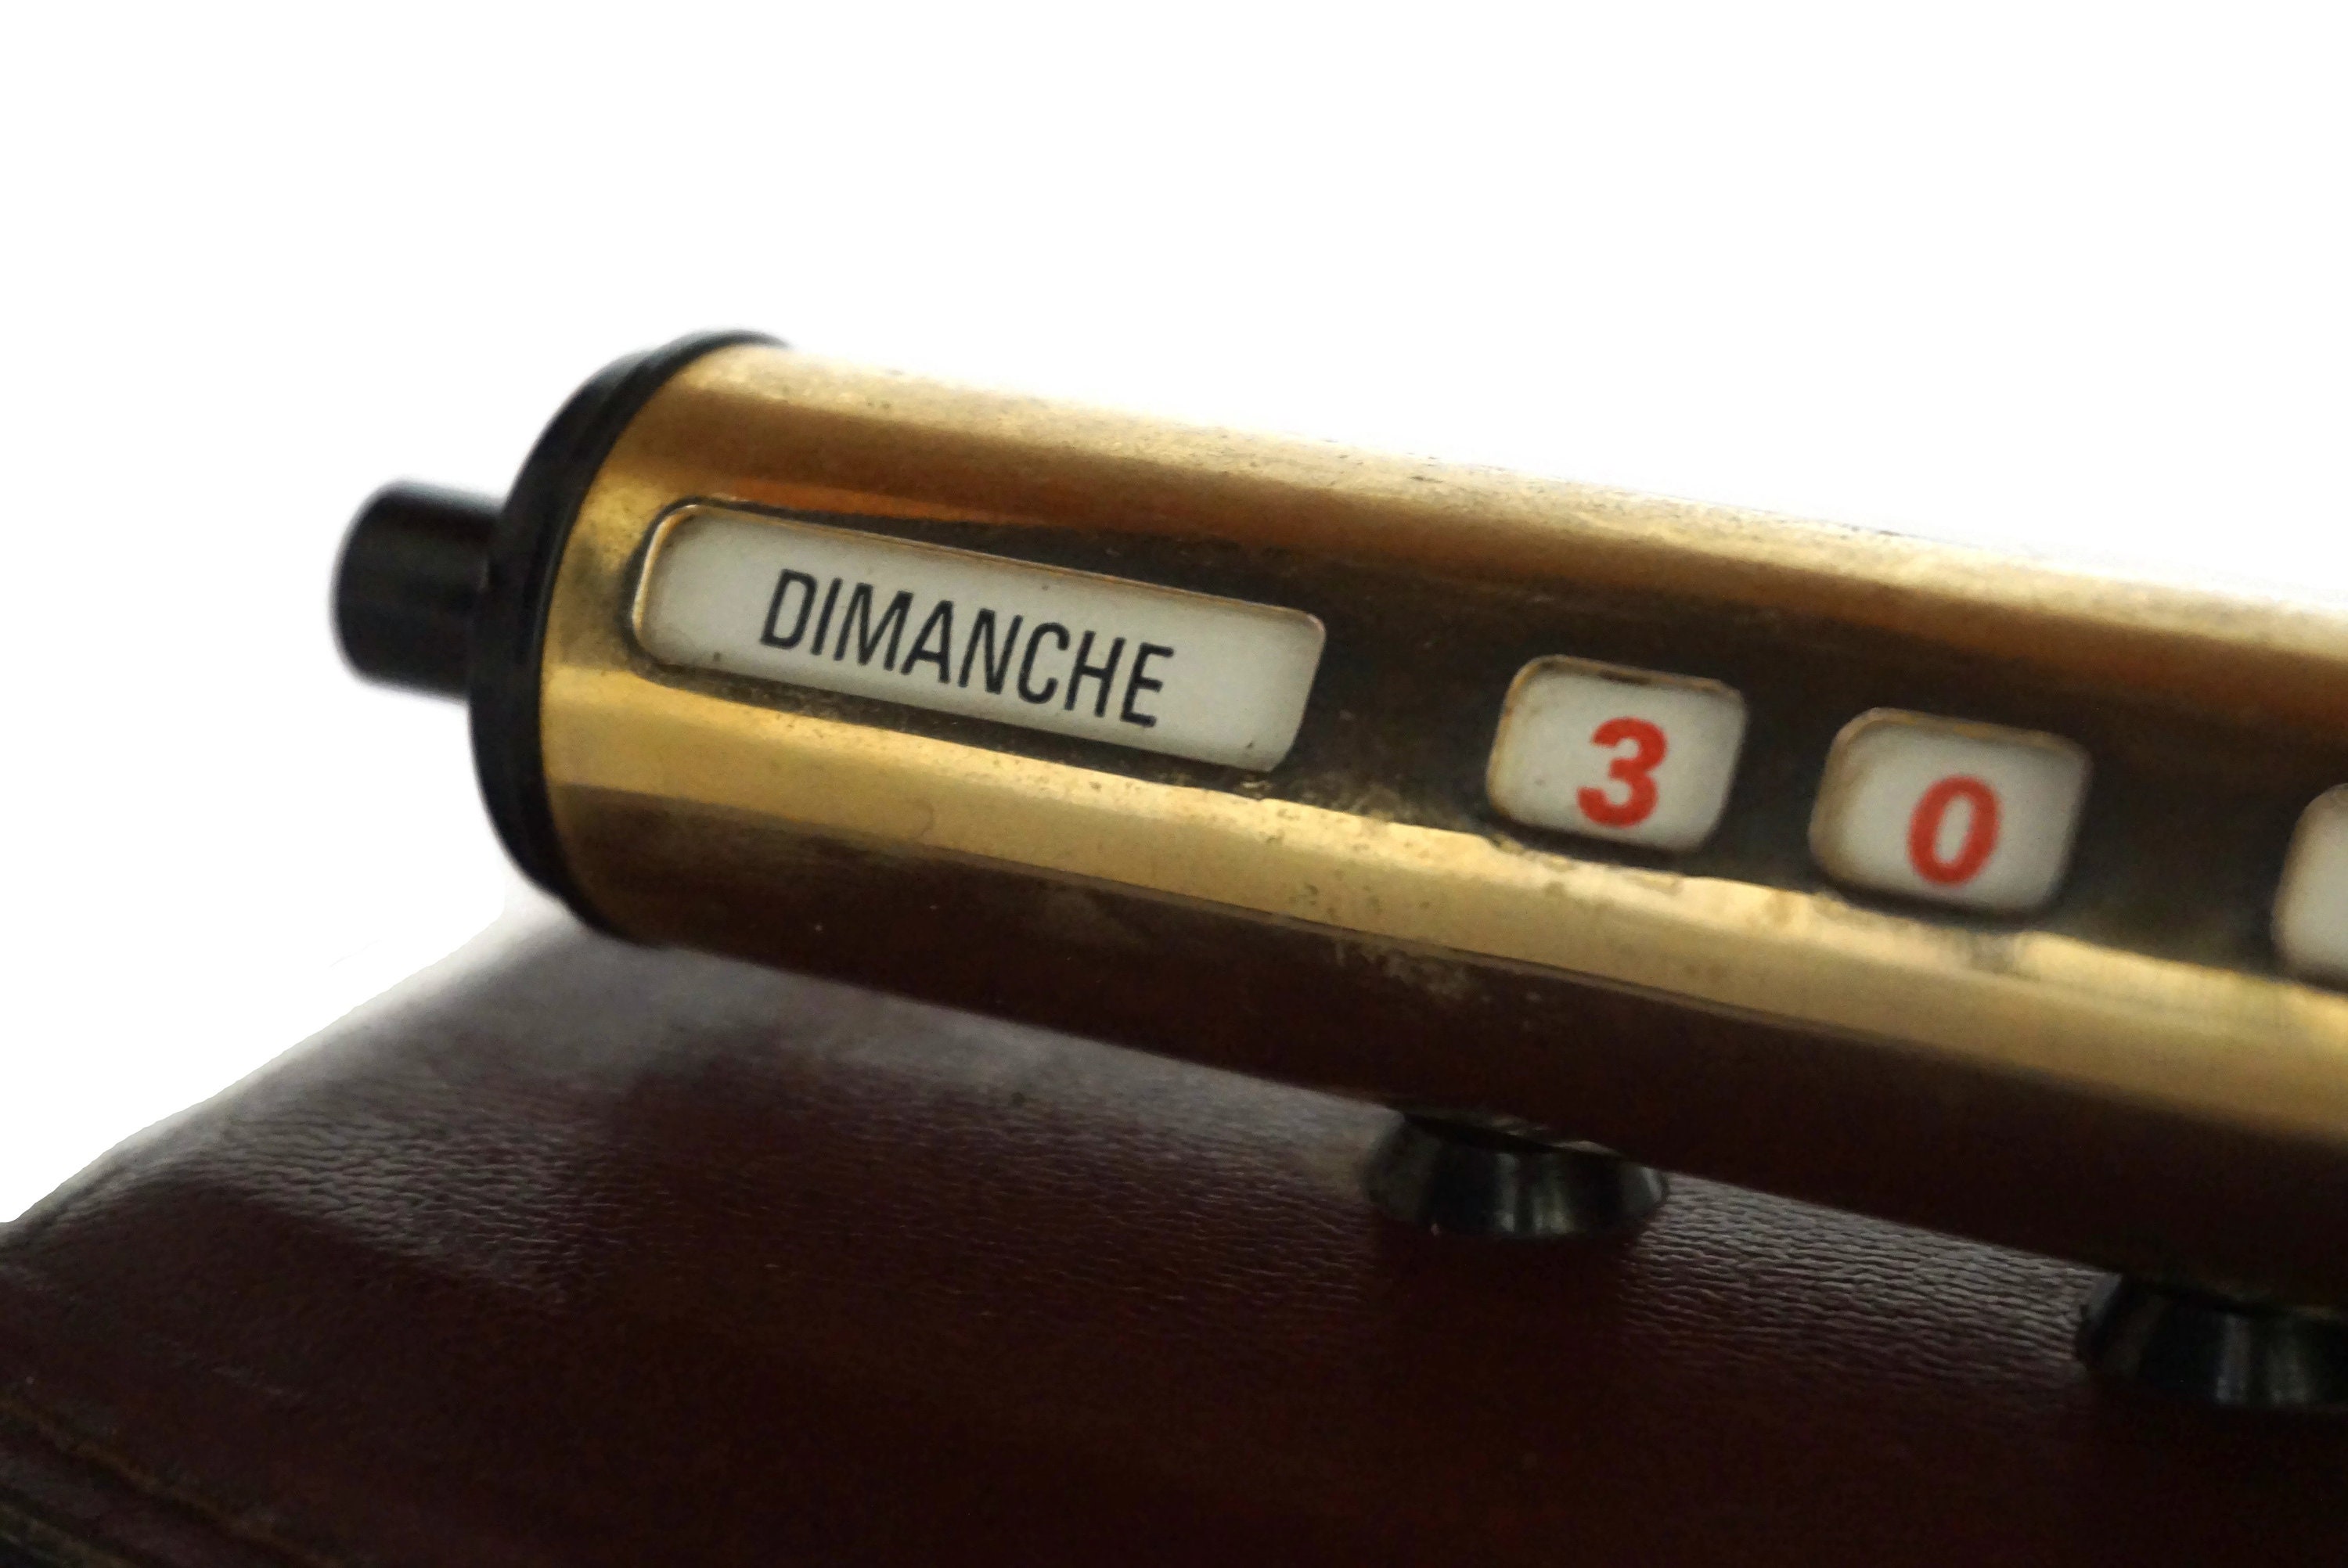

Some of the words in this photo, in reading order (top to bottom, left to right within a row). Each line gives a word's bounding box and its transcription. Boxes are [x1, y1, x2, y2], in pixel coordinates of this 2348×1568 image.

[760, 568, 1175, 728] DIMANCHE
[1576, 716, 1668, 829] 3
[1907, 775, 2000, 888] 0
